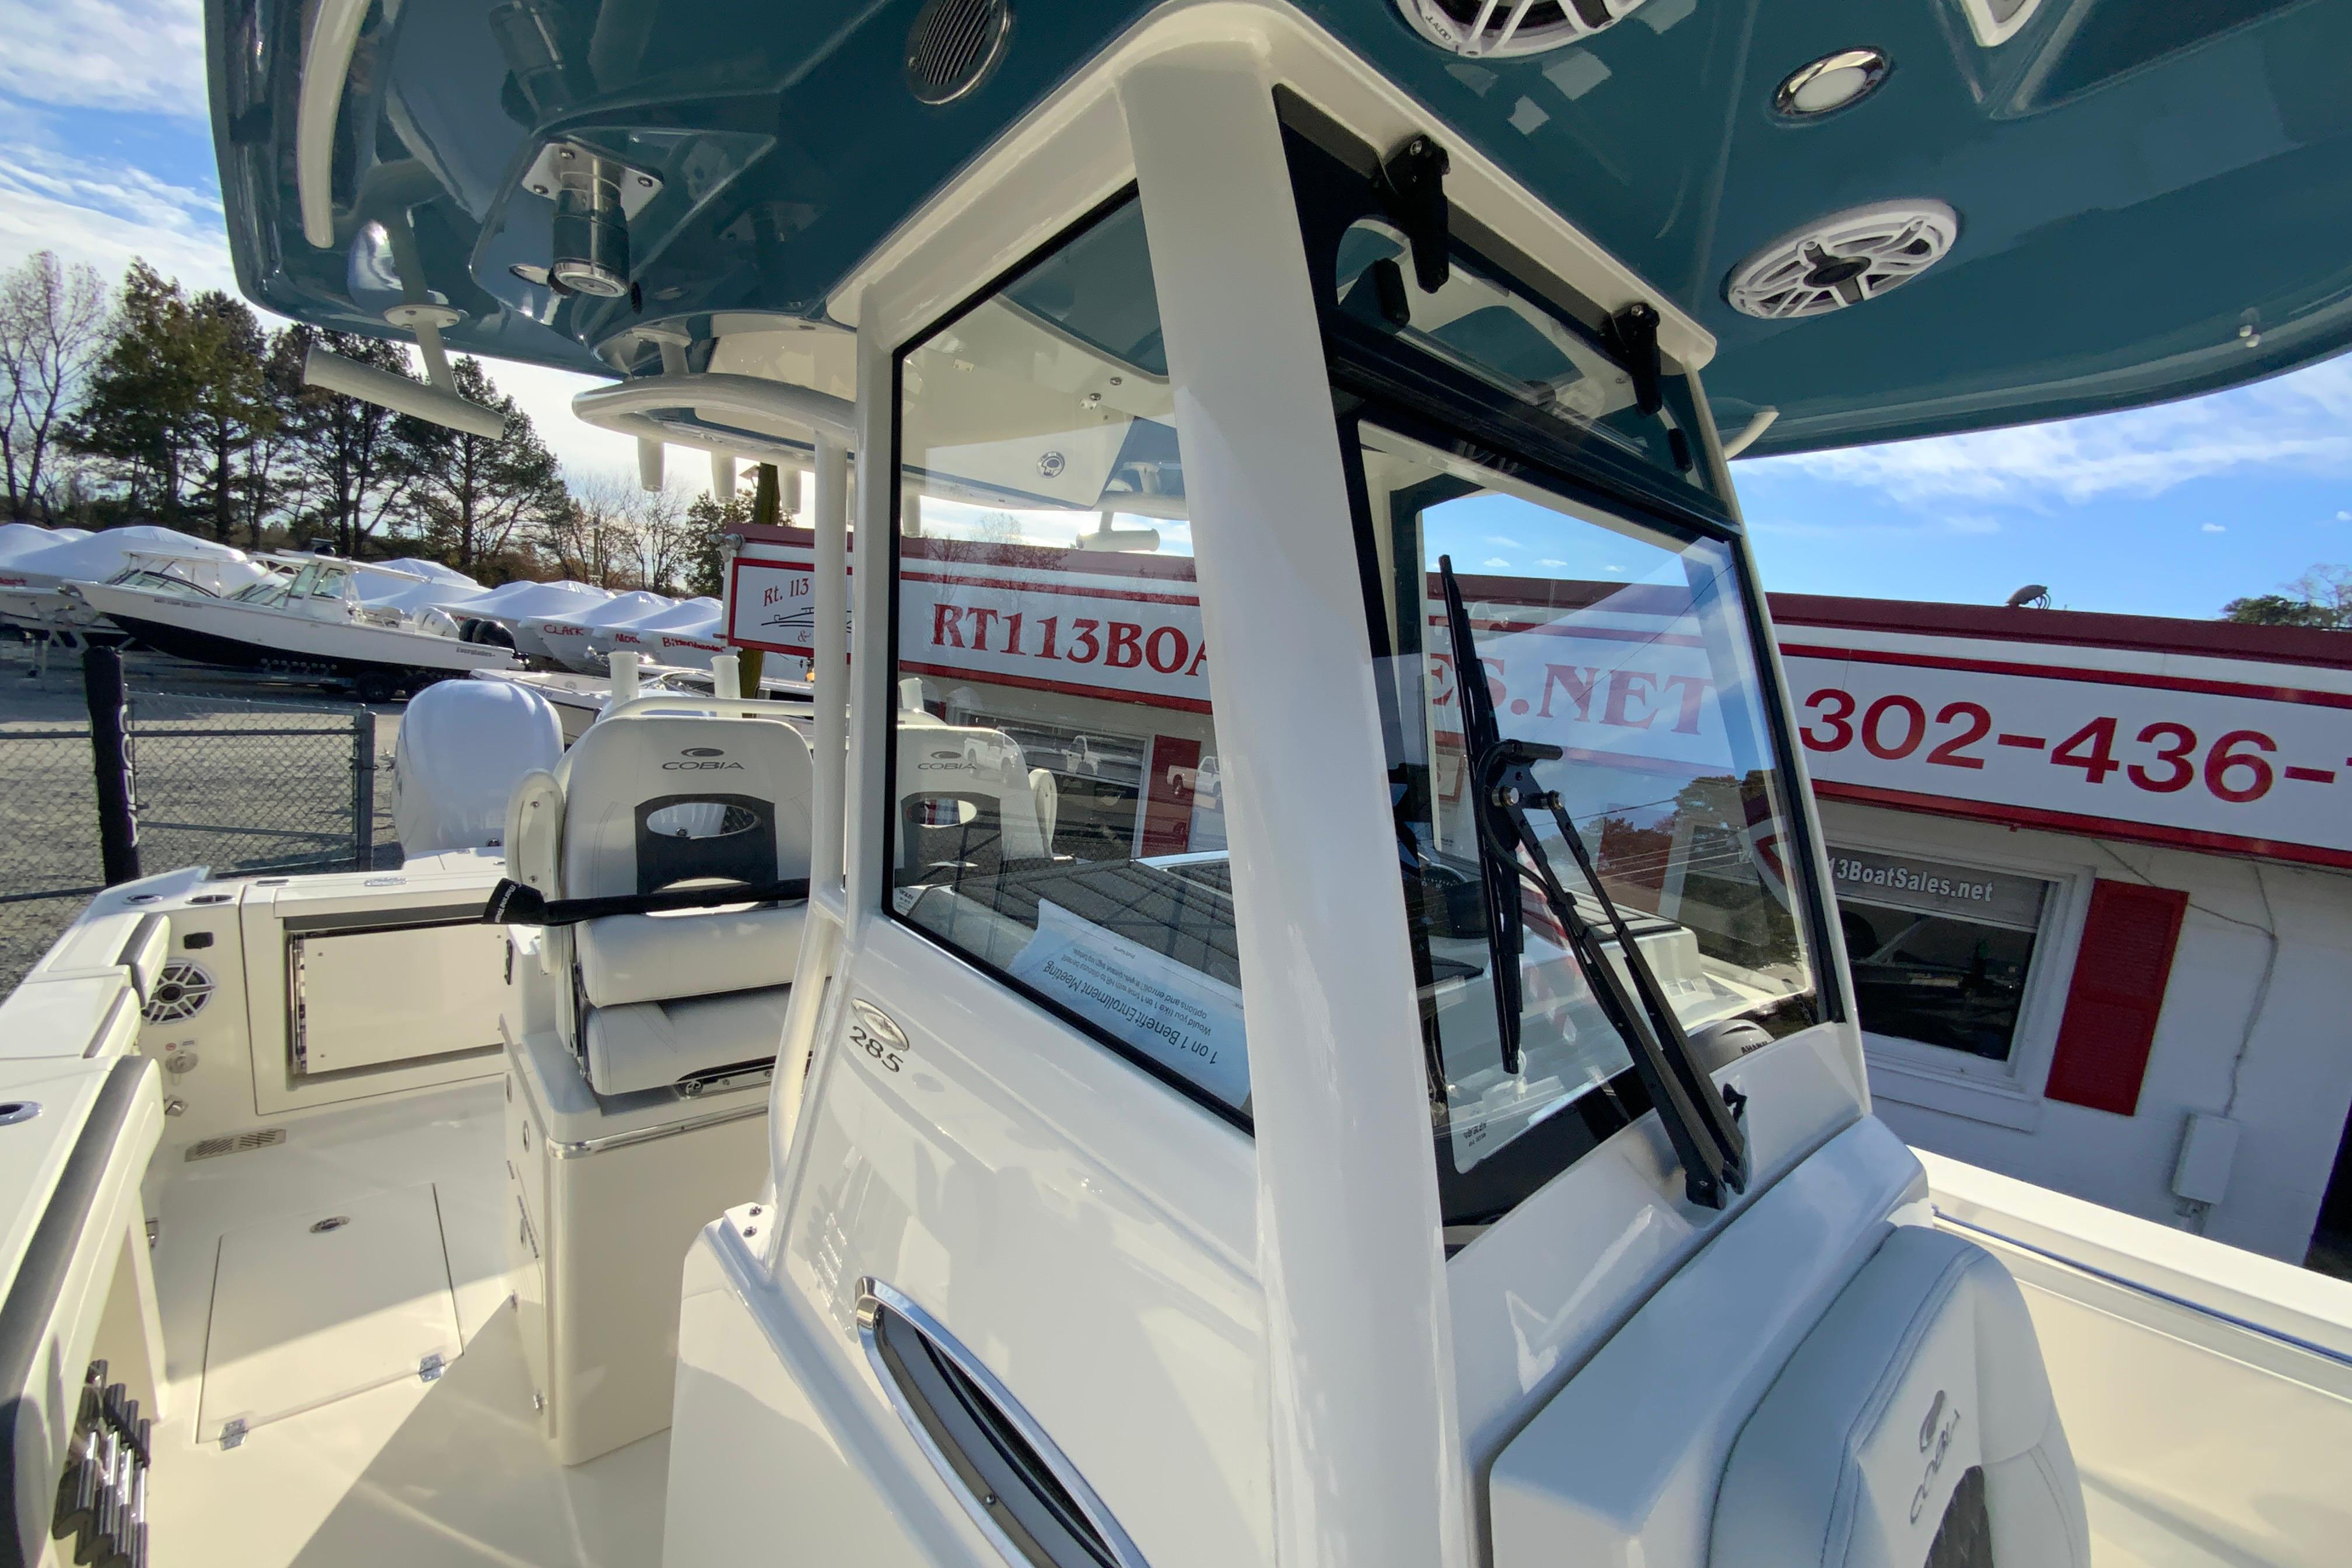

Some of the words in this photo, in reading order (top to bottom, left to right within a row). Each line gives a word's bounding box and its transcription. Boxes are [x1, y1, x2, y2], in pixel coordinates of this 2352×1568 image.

[763, 585, 783, 607] Rt.
[789, 578, 809, 597] 113
[1797, 688, 2352, 804] 302-436-
[662, 761, 745, 770] COBIA
[1043, 960, 1082, 992] Meeting
[1100, 973, 1107, 982] to
[1107, 976, 1115, 986] HR
[1115, 981, 1128, 992] with
[1080, 982, 1138, 1022] Enrollment
[1144, 998, 1153, 1006] on
[1164, 994, 1180, 1006] and
[1159, 1004, 1174, 1017] like
[1174, 1011, 1188, 1024] you
[1181, 1002, 1207, 1019] options
[1134, 1011, 1181, 1045] Benefit
[1188, 1021, 1212, 1036] Would
[849, 1026, 904, 1072] 285
[1180, 1036, 1188, 1049] 1
[1191, 1041, 1209, 1056] on
[1209, 1051, 1218, 1065] 1
